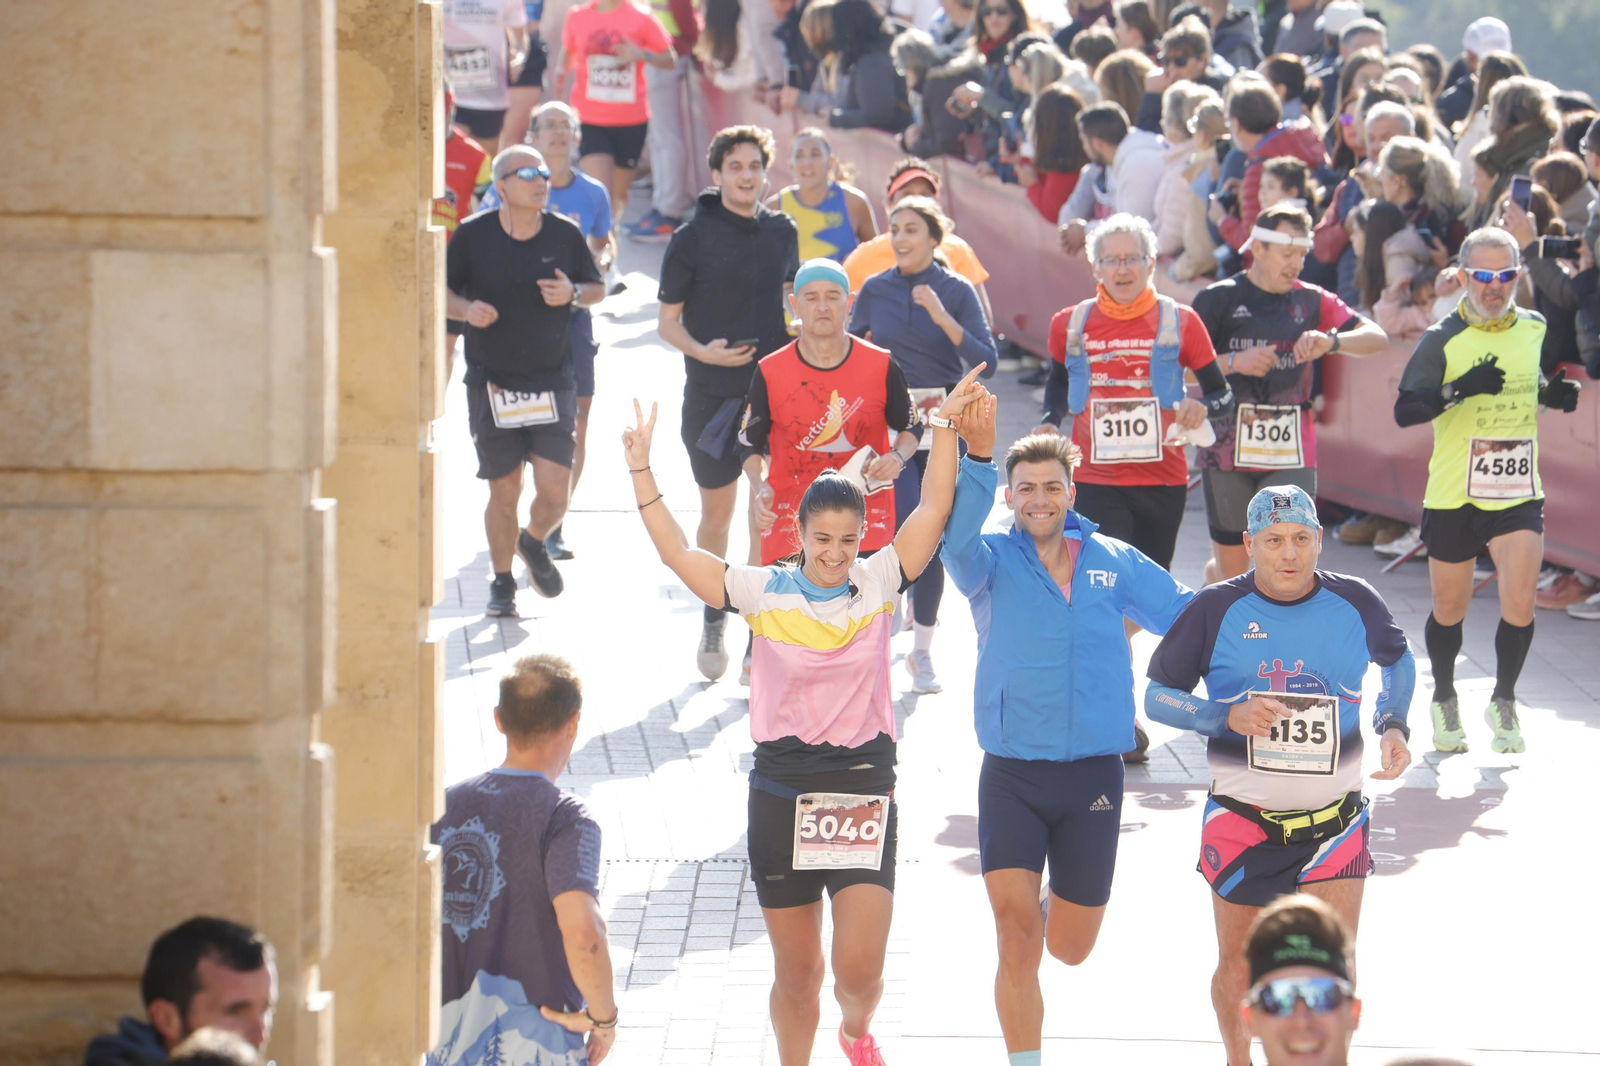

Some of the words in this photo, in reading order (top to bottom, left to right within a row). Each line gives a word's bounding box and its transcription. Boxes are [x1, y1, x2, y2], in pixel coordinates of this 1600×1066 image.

[795, 396, 847, 451] verticalia
[1102, 418, 1148, 438] 3110
[1246, 424, 1291, 443] 1306
[1474, 457, 1529, 476] 4588
[1242, 632, 1268, 640] VIATOR
[1301, 666, 1318, 676] CLUB
[1155, 692, 1184, 709] Carmona
[1181, 700, 1199, 715] Páez
[799, 814, 881, 842] 5040
